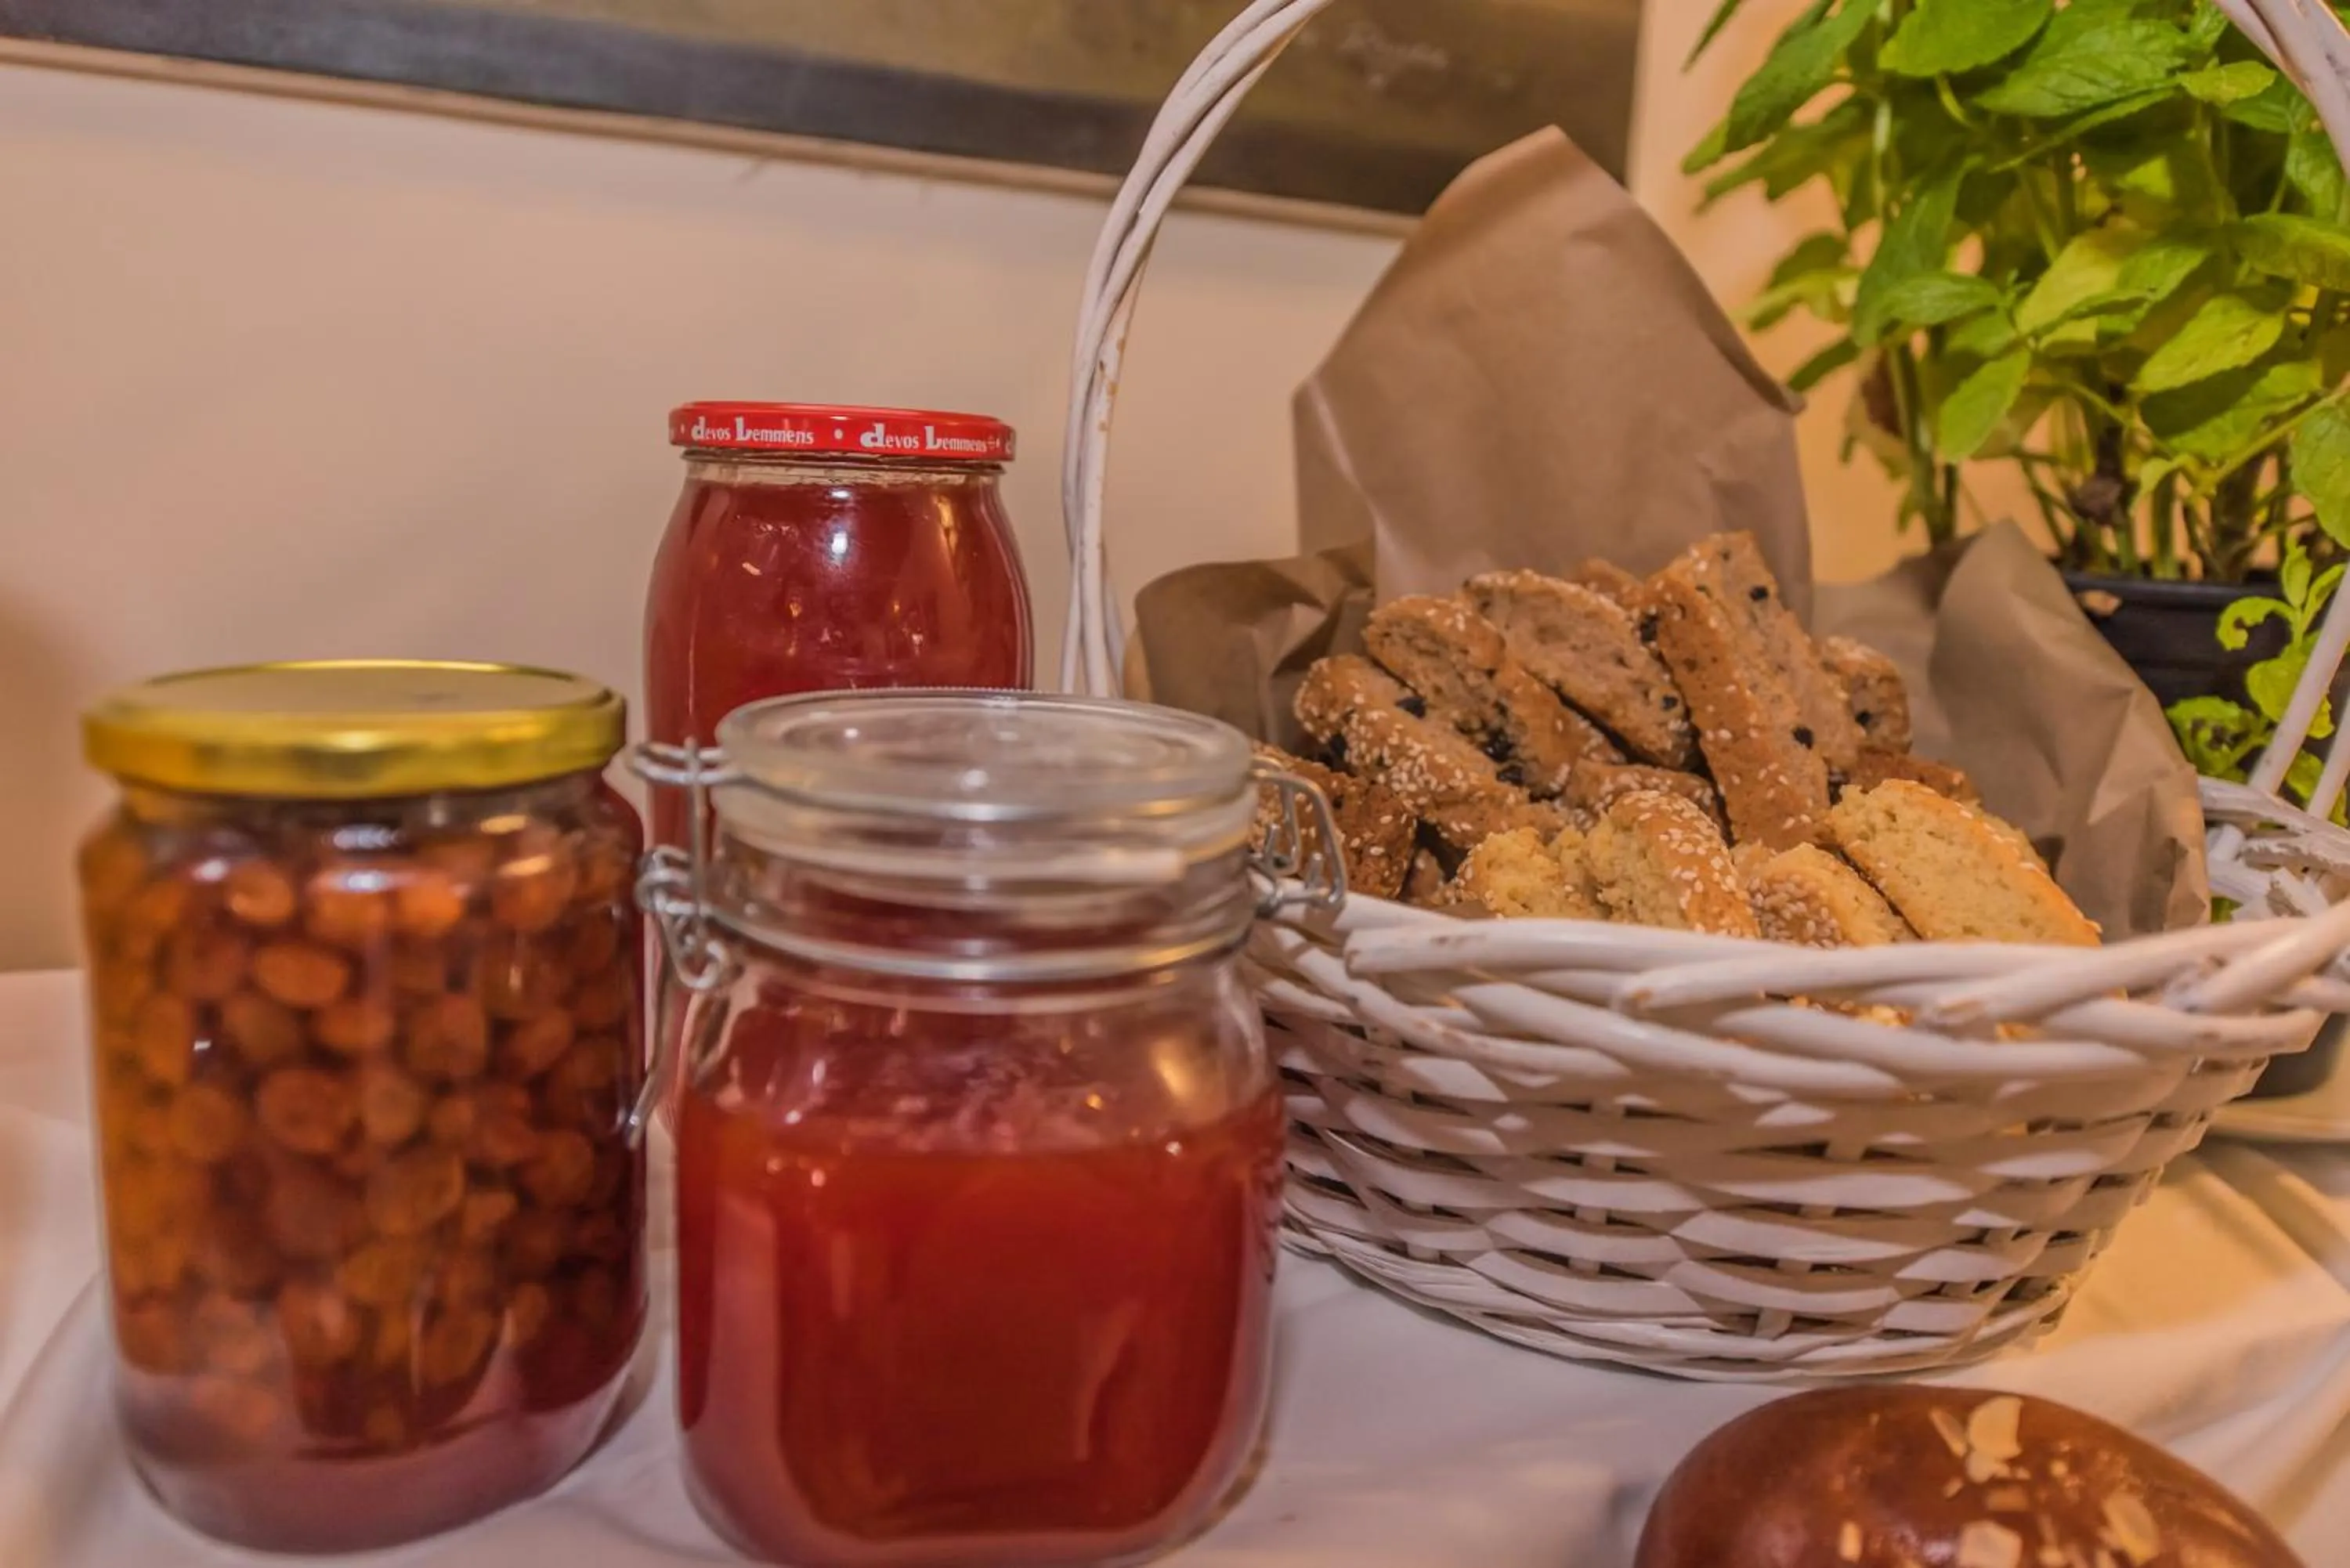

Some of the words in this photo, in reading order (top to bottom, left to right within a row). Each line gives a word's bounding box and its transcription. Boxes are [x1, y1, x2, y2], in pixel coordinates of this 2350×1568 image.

[691, 416, 731, 441] devos
[735, 417, 815, 444] Lemmens
[859, 423, 919, 449] devos
[924, 426, 987, 453] Lemmens
